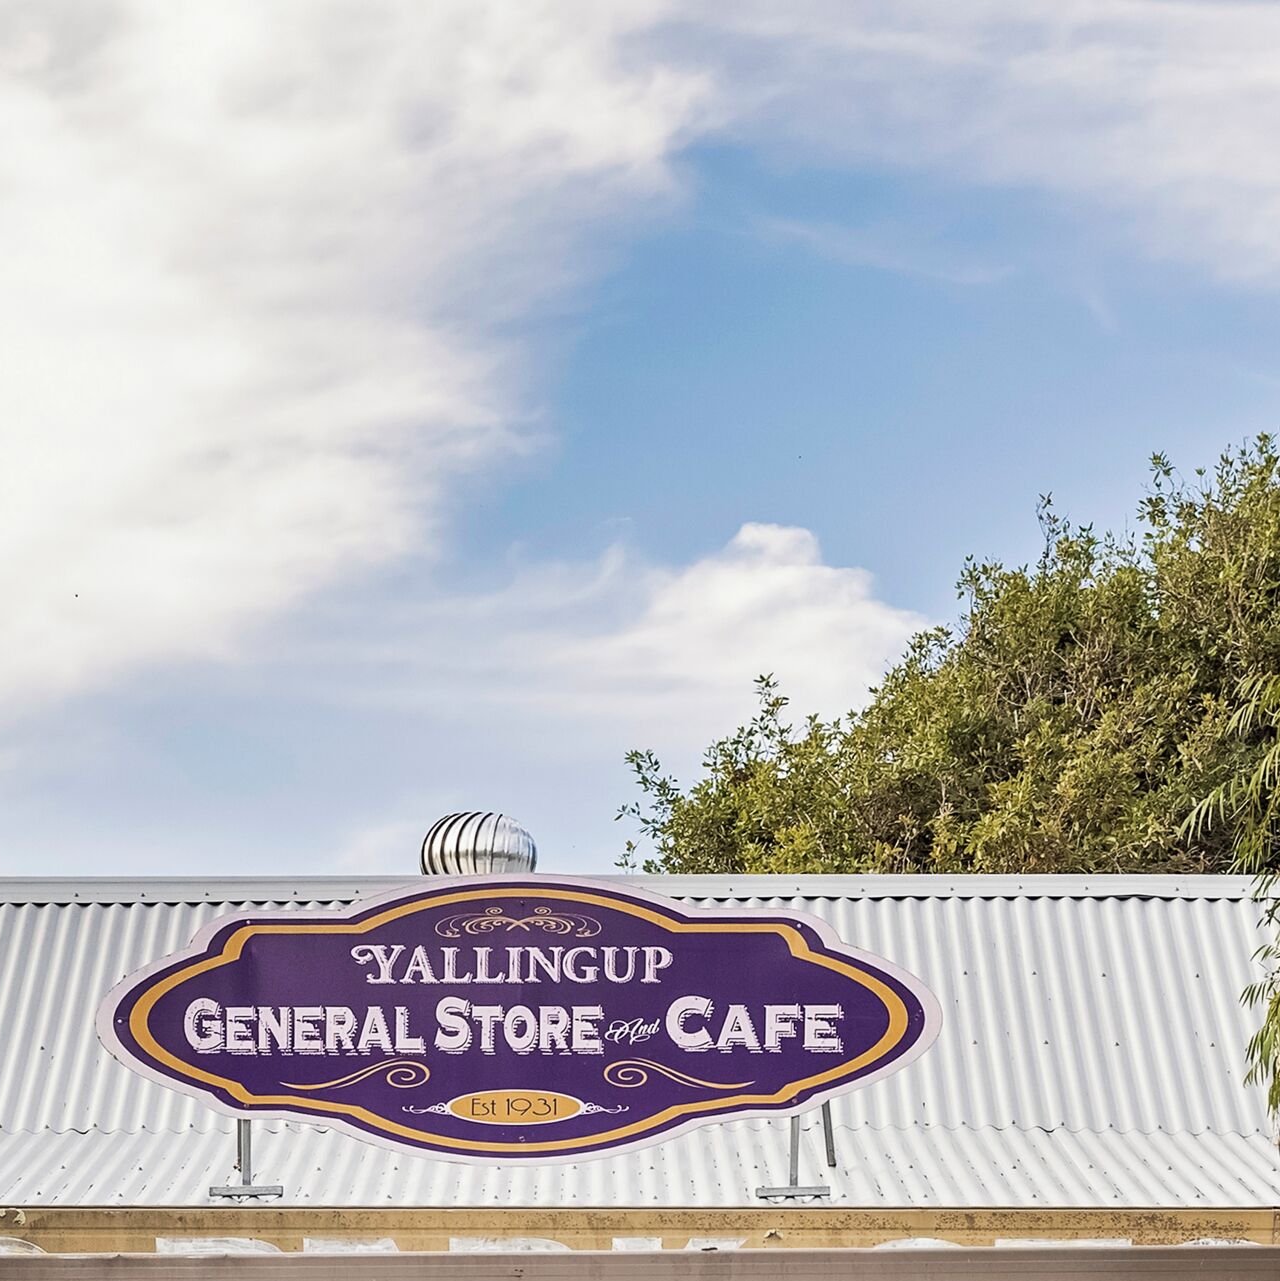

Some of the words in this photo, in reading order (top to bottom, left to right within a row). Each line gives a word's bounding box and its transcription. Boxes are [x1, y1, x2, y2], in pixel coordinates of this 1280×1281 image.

[351, 944, 673, 986] YALLINGUP
[183, 997, 427, 1055] GENERAL
[434, 995, 604, 1055] STORE
[605, 1016, 660, 1045] And
[665, 995, 842, 1054] CAFE
[470, 1097, 497, 1117] Est
[501, 1097, 559, 1118] 1931
